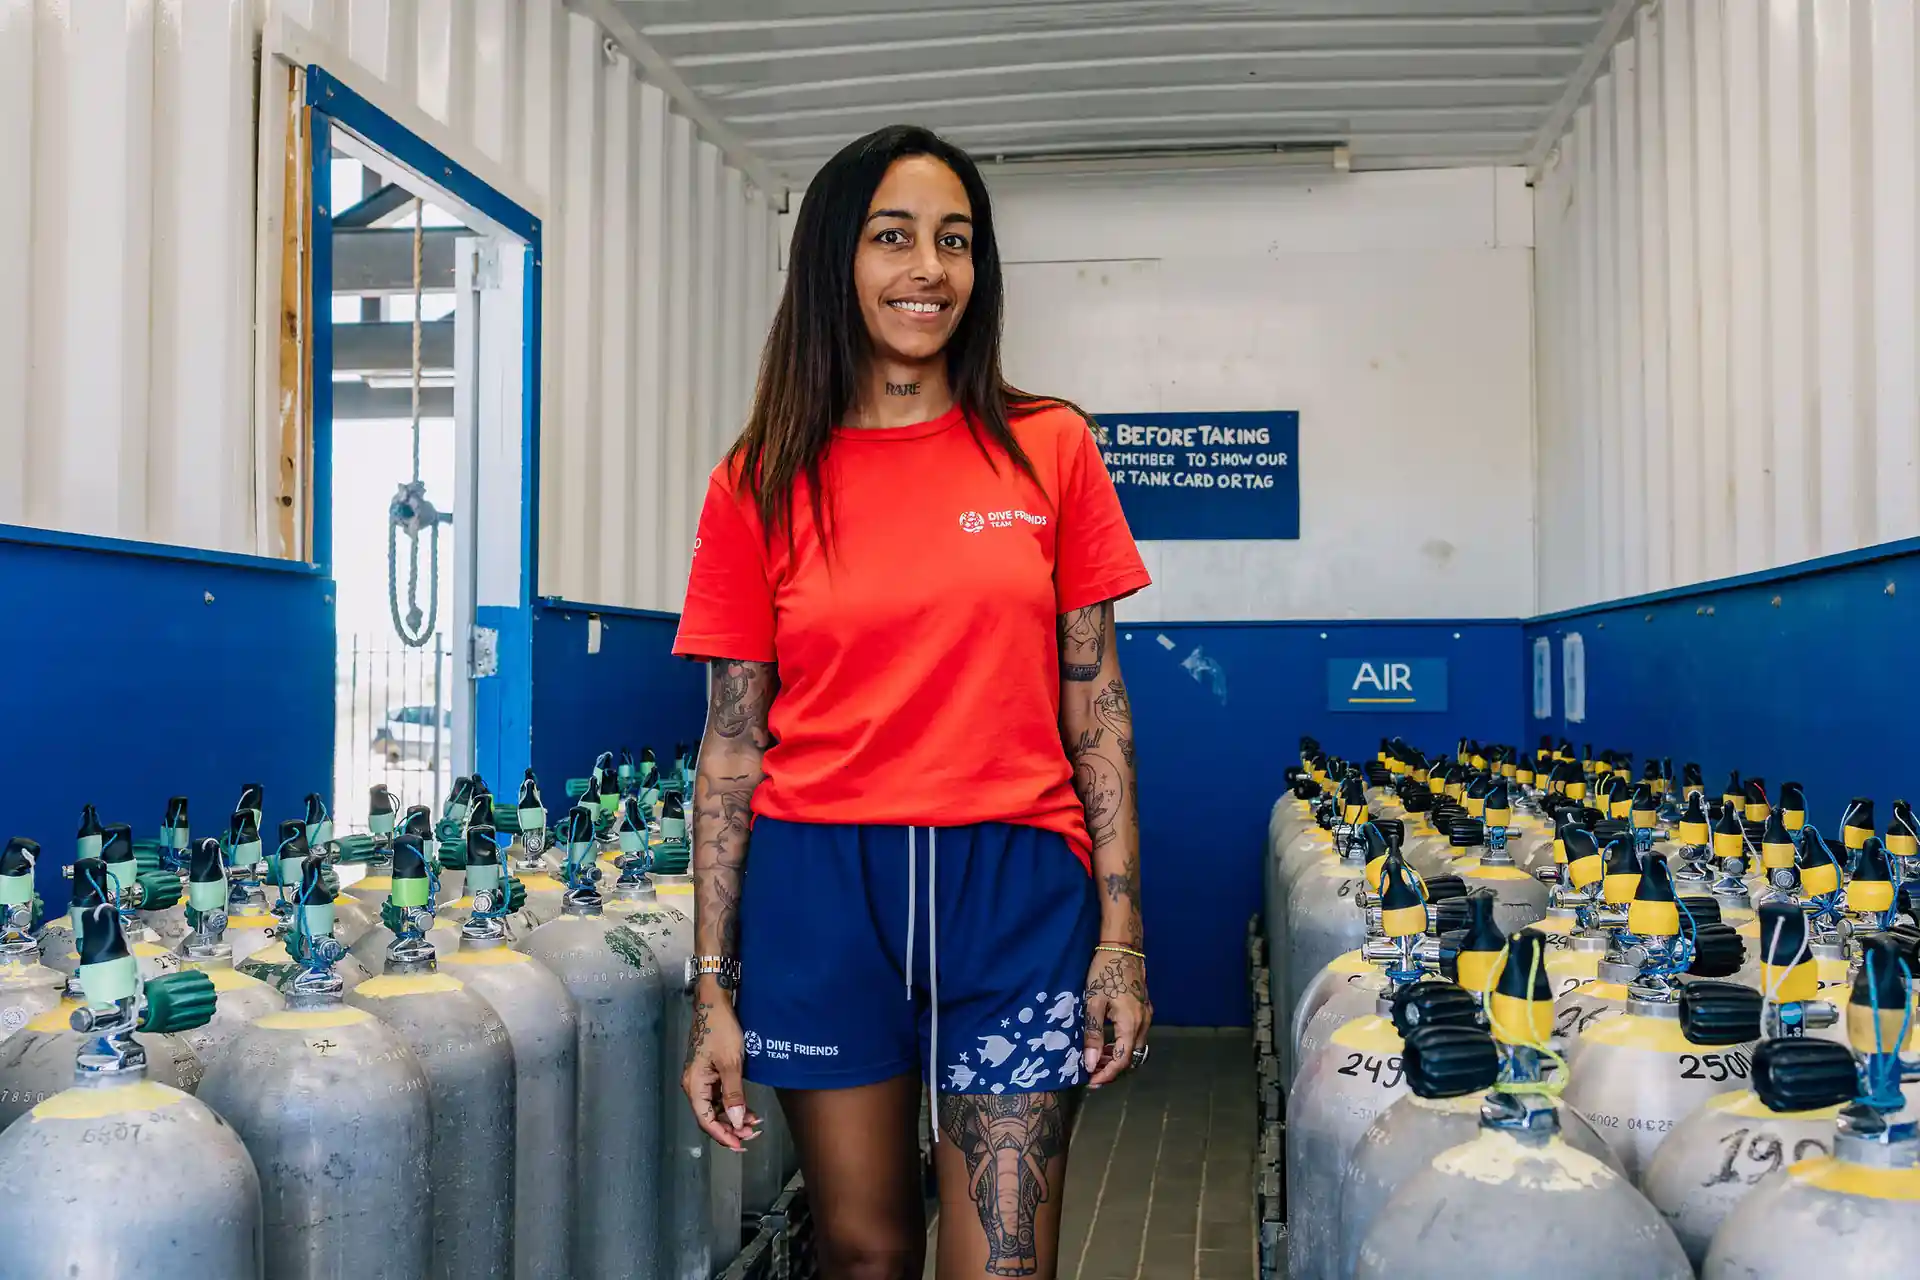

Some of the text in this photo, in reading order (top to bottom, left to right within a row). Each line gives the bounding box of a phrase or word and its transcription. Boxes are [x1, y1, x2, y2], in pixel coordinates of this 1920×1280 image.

[885, 381, 921, 396] RARE
[1116, 424, 1197, 447] BEFORE
[1198, 425, 1270, 446] TAKING
[1103, 452, 1288, 467] REMEMBER TO SHOW OUR
[1128, 470, 1171, 486] TANK
[1173, 472, 1214, 488] CARD
[1217, 474, 1242, 489] OR
[1243, 474, 1274, 489] TAG
[987, 510, 1013, 521] DIVE
[990, 520, 1012, 528] TEAM
[1351, 662, 1413, 691] AIR
[766, 1039, 839, 1056] DIVE FRIENDS
[767, 1050, 789, 1060] TEAM
